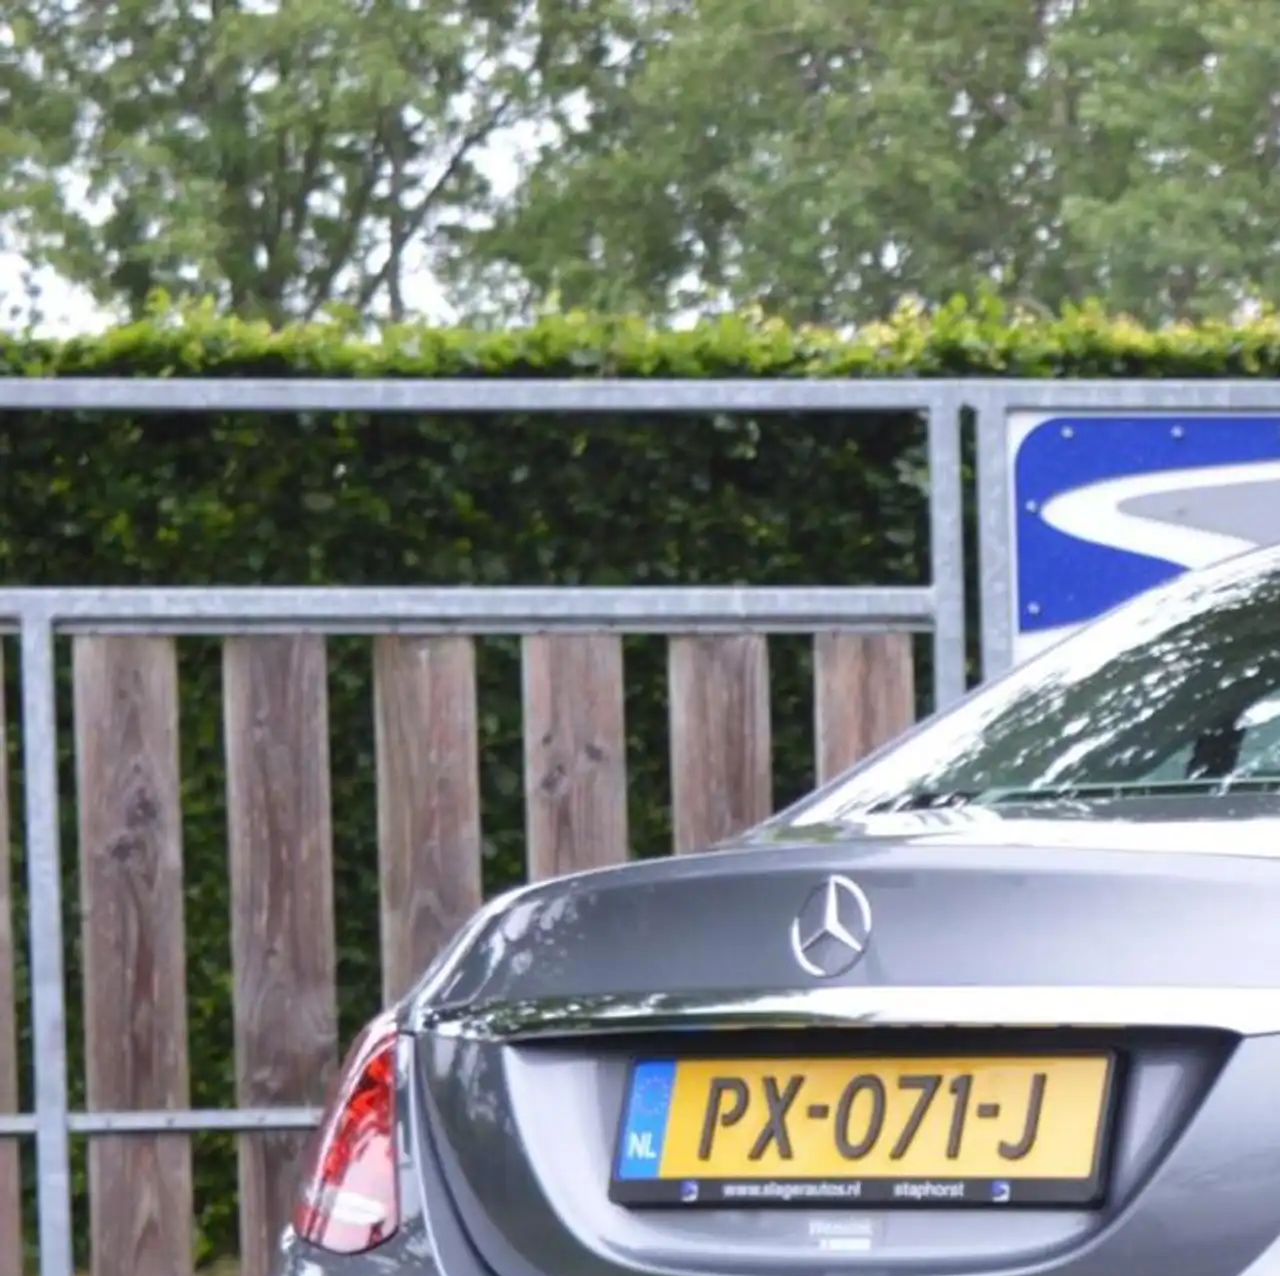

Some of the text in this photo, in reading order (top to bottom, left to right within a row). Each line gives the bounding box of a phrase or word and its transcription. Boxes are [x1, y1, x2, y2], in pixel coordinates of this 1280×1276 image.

[697, 1073, 1048, 1162] PX-071-J
[627, 1132, 656, 1159] NL
[722, 1181, 965, 1200] www.slagerautos.nl staphorst
